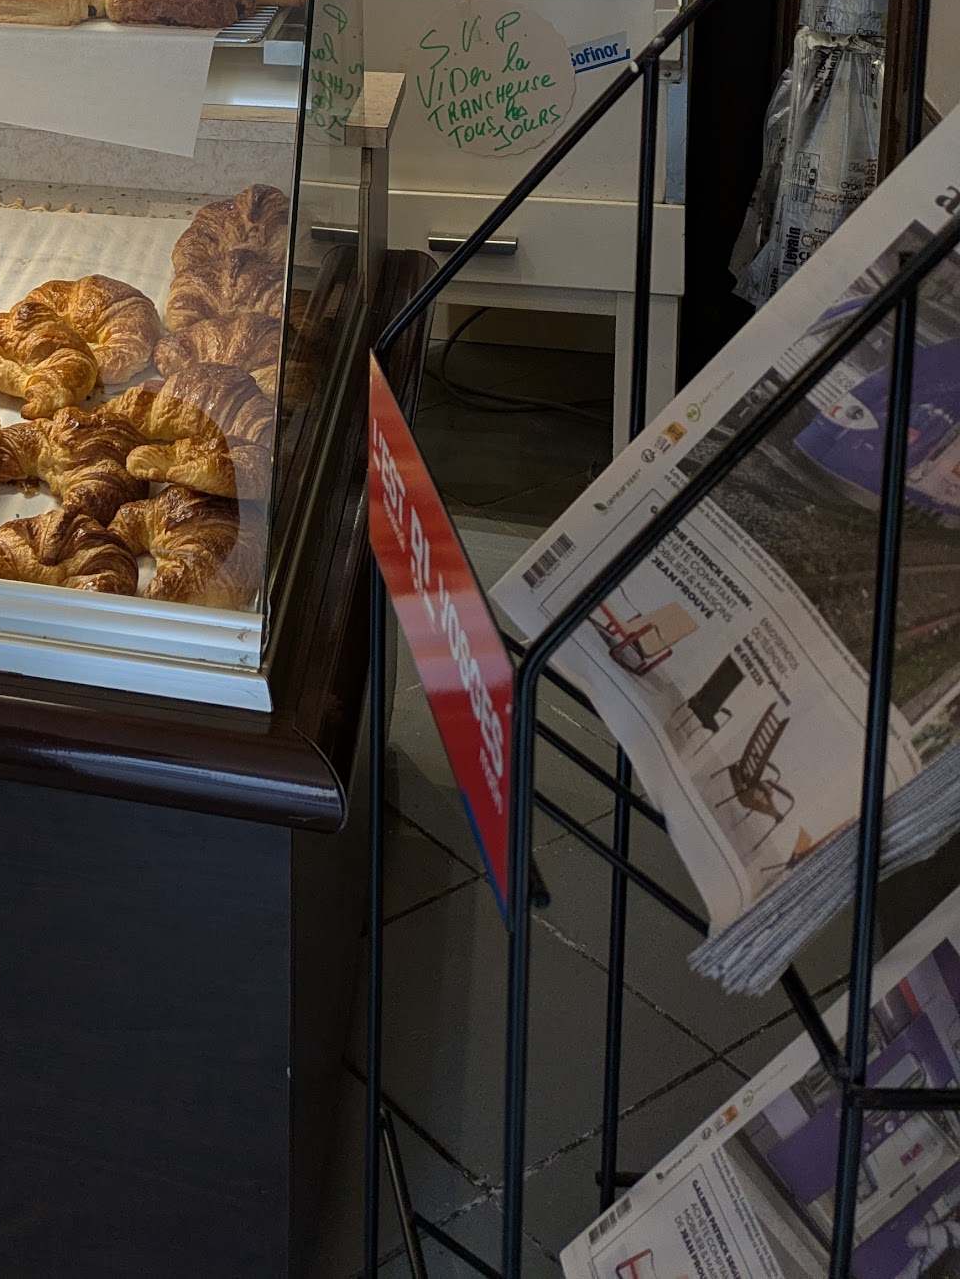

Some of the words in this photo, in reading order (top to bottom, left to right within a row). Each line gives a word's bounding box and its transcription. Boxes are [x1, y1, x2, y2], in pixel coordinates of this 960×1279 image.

[656, 544, 689, 577] OBILIER
[663, 535, 691, 564] CHÈTE
[686, 538, 724, 578] PATRICK
[651, 555, 677, 582] JEAN
[675, 579, 715, 620] PROUVÉ
